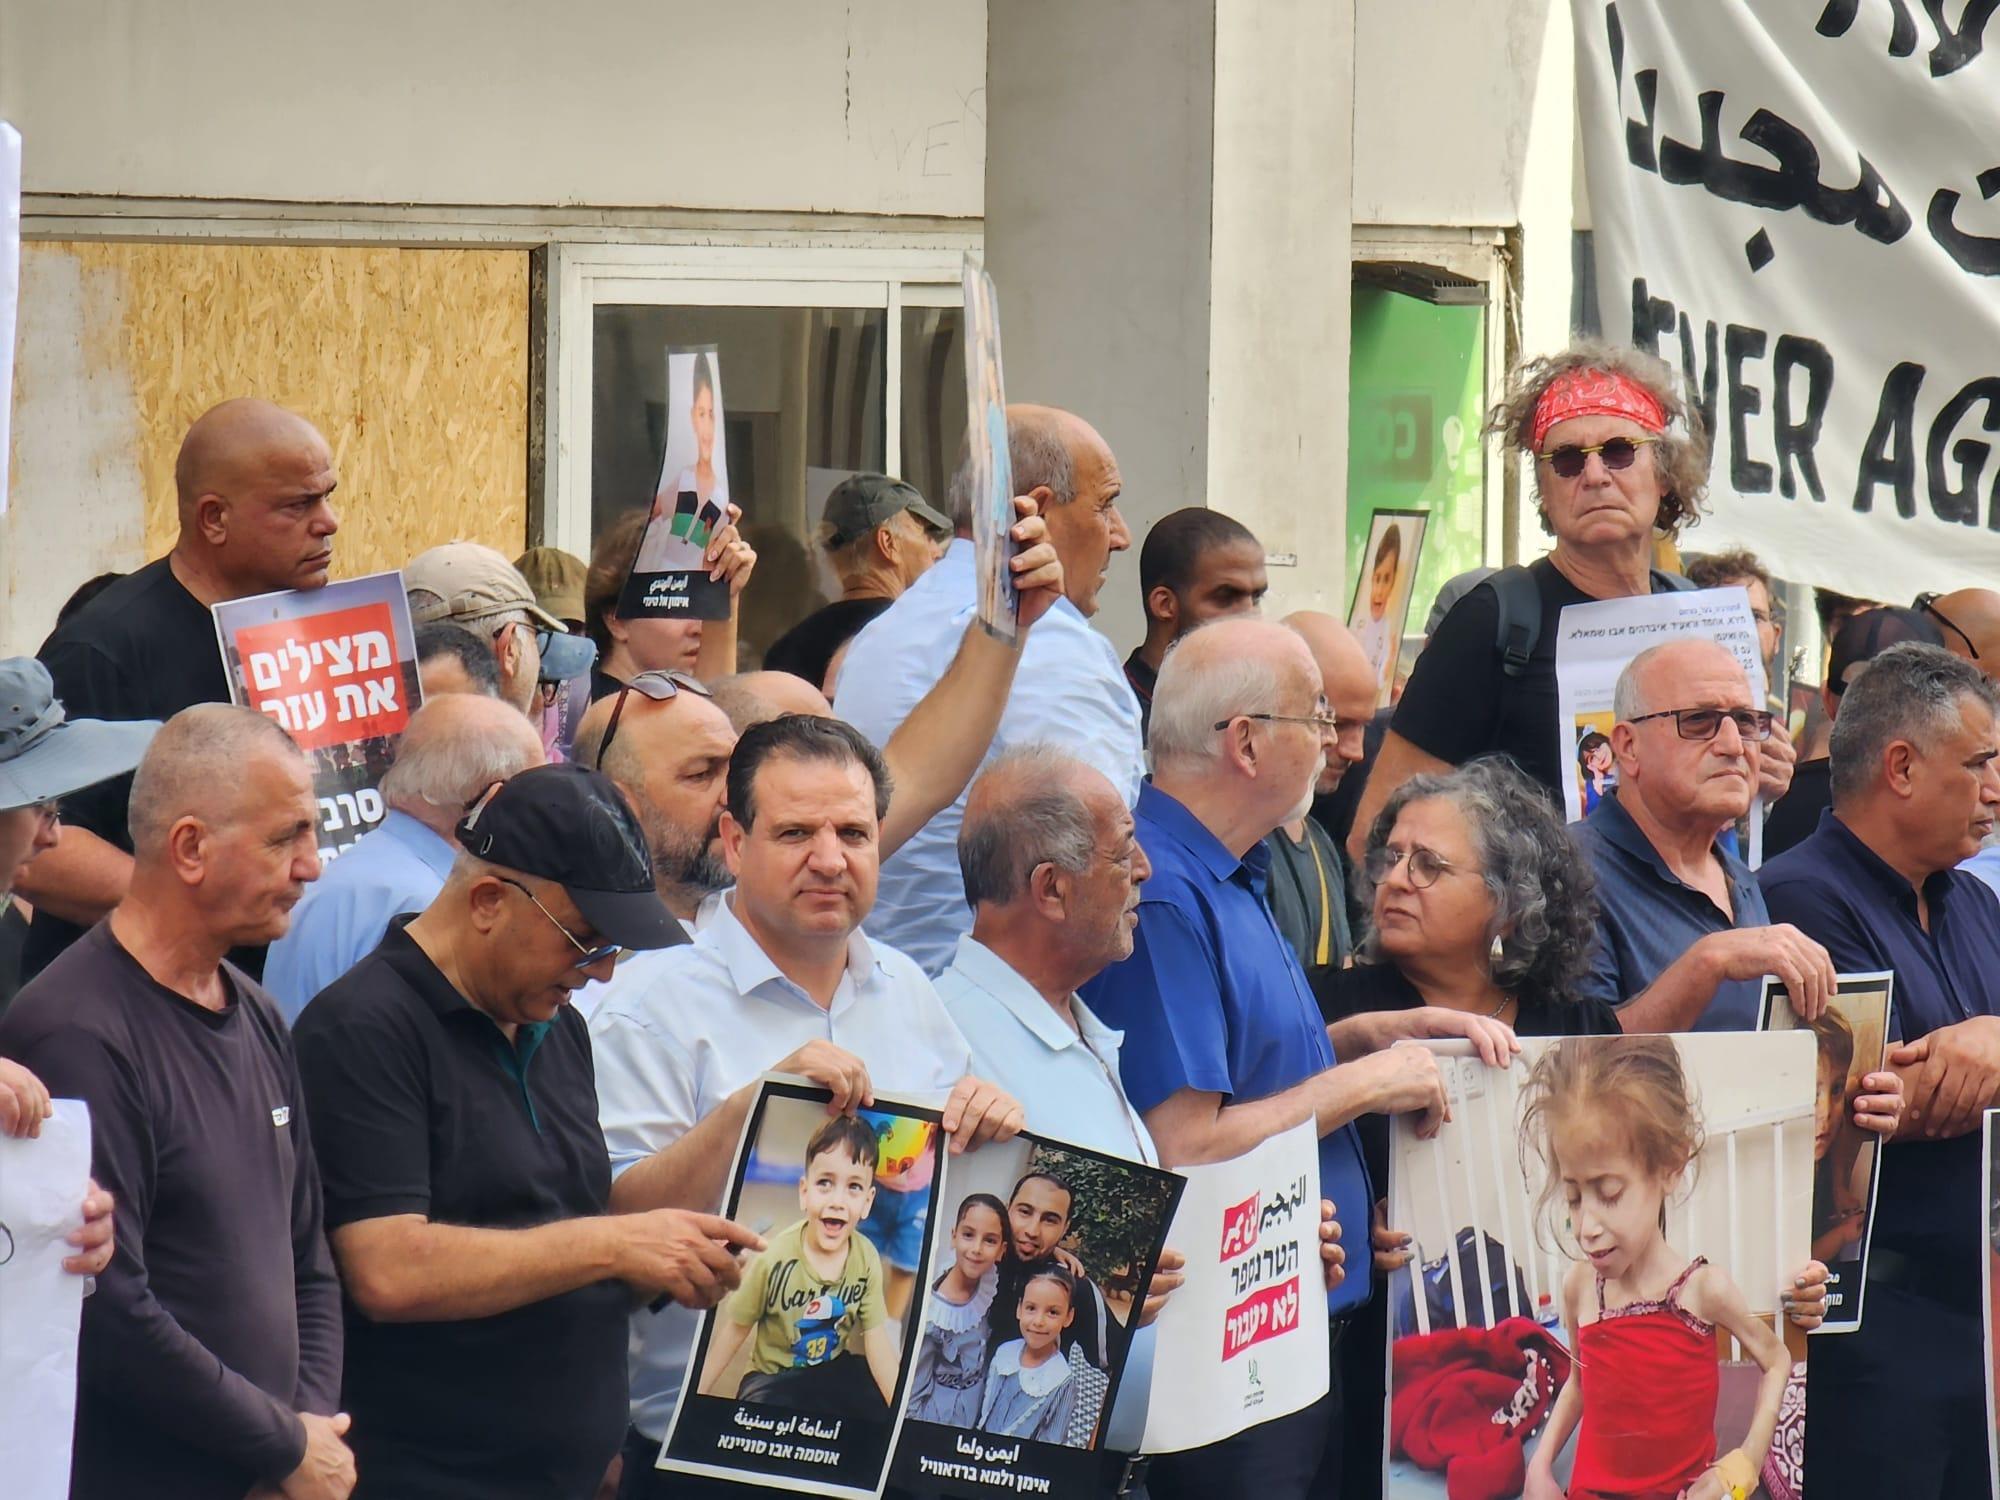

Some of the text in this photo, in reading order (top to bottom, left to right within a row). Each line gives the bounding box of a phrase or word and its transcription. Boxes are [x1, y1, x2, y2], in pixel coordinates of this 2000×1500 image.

[1852, 361, 2000, 532] AG
[248, 630, 393, 692] מצילים
[333, 675, 400, 723] את
[1231, 1239, 1300, 1297] הטרנספר
[1227, 1286, 1298, 1351] לא יעבור
[733, 1407, 774, 1431] سنينة
[797, 1417, 842, 1441] أسامة
[767, 1442, 794, 1460] אבו
[794, 1446, 841, 1466] אוסמה
[955, 1434, 1021, 1465] ايمن ولما
[919, 1455, 1051, 1494] אימן ולמא ברדאוויל
